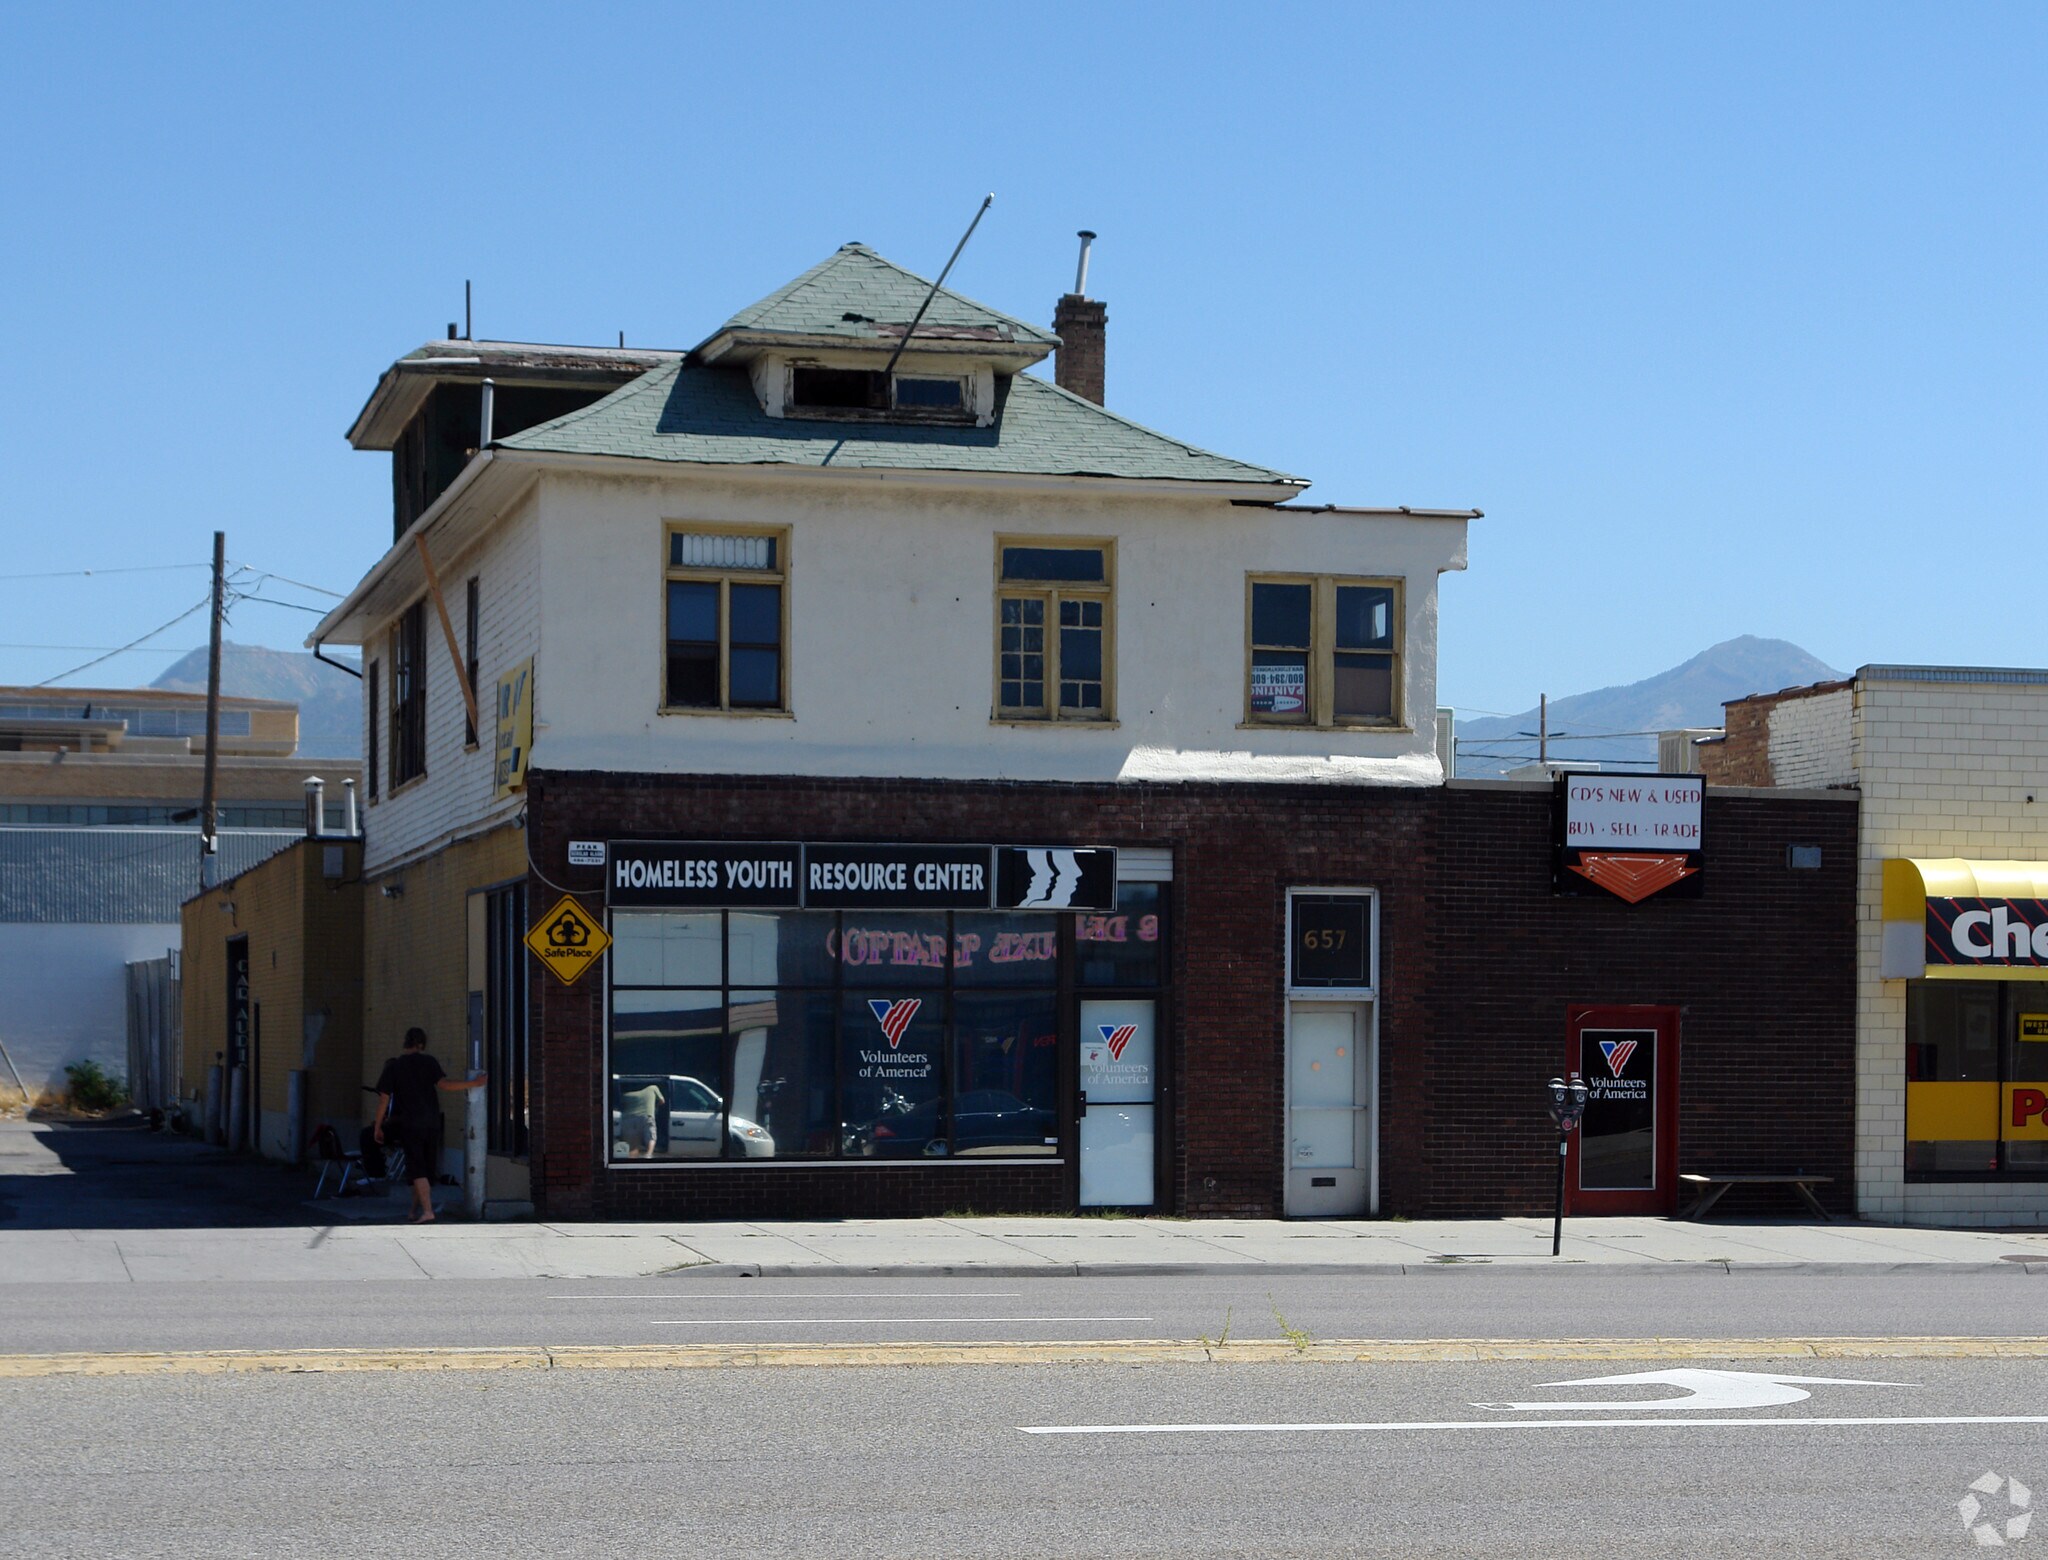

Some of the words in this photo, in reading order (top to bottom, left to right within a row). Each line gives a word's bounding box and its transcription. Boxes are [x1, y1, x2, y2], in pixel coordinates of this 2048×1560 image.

[1608, 788, 1642, 803] NEW
[1647, 789, 1658, 804] &
[1664, 789, 1701, 804] USED
[1568, 821, 1595, 835] BUY
[1610, 822, 1640, 836] SELL
[1653, 823, 1699, 838] TRADE
[615, 860, 718, 889] HOMELESS
[726, 860, 793, 890] YOUTH
[809, 862, 907, 892] RESOURCE
[913, 862, 984, 892] CENTER
[1304, 930, 1346, 950] 657
[544, 947, 567, 958] Safe
[566, 947, 592, 958] Place
[859, 1050, 928, 1064] Volunteers
[858, 1065, 874, 1078] of
[1088, 1063, 1149, 1073] Volunteers
[1087, 1073, 1100, 1084] of
[1103, 1074, 1149, 1084] America
[1590, 1077, 1646, 1088] Volunteers
[1589, 1088, 1602, 1100] of
[1603, 1088, 1647, 1100] America
